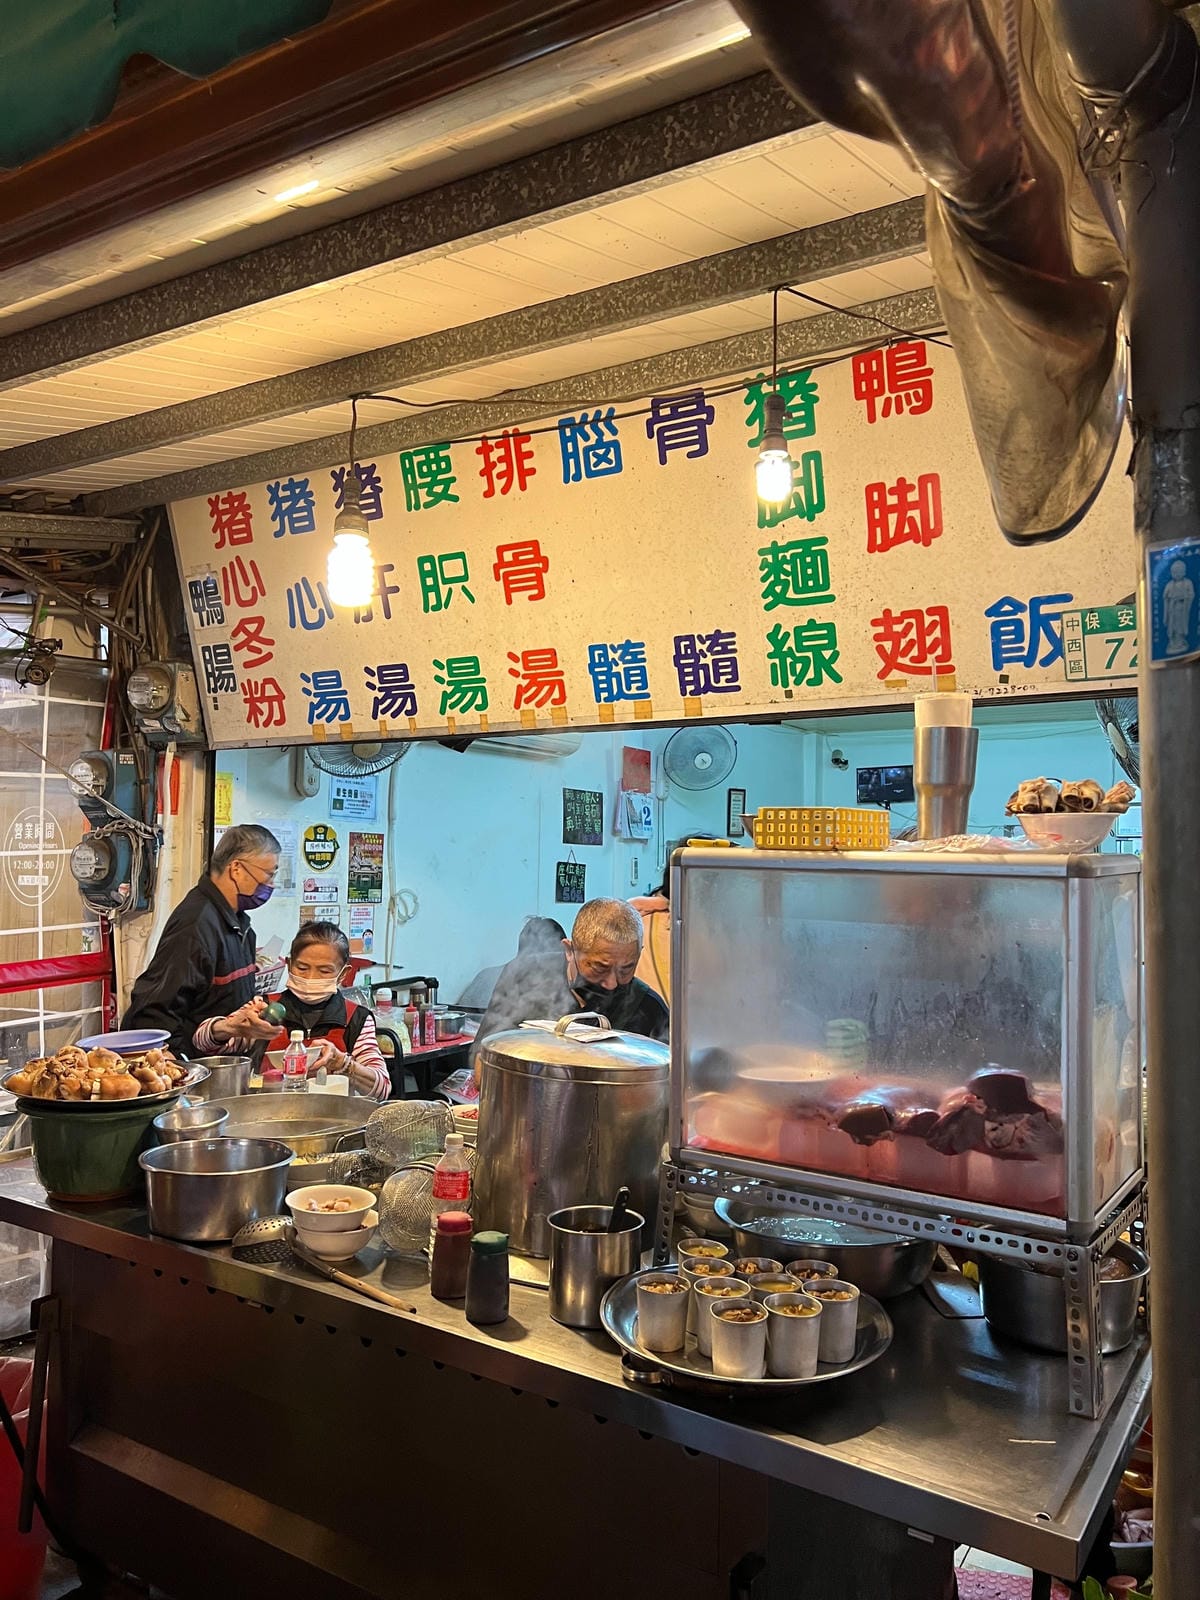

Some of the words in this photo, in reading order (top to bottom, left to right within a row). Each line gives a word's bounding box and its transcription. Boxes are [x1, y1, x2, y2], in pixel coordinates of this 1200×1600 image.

[207, 491, 287, 728] 猪心冬粉
[267, 478, 351, 724] 猪心湯
[475, 428, 566, 709] 排骨湯
[188, 575, 237, 694] 鴨腸
[984, 592, 1074, 671] 飯
[1066, 617, 1084, 674] 中西區
[1085, 608, 1134, 631] 保安
[643, 806, 652, 826] 2
